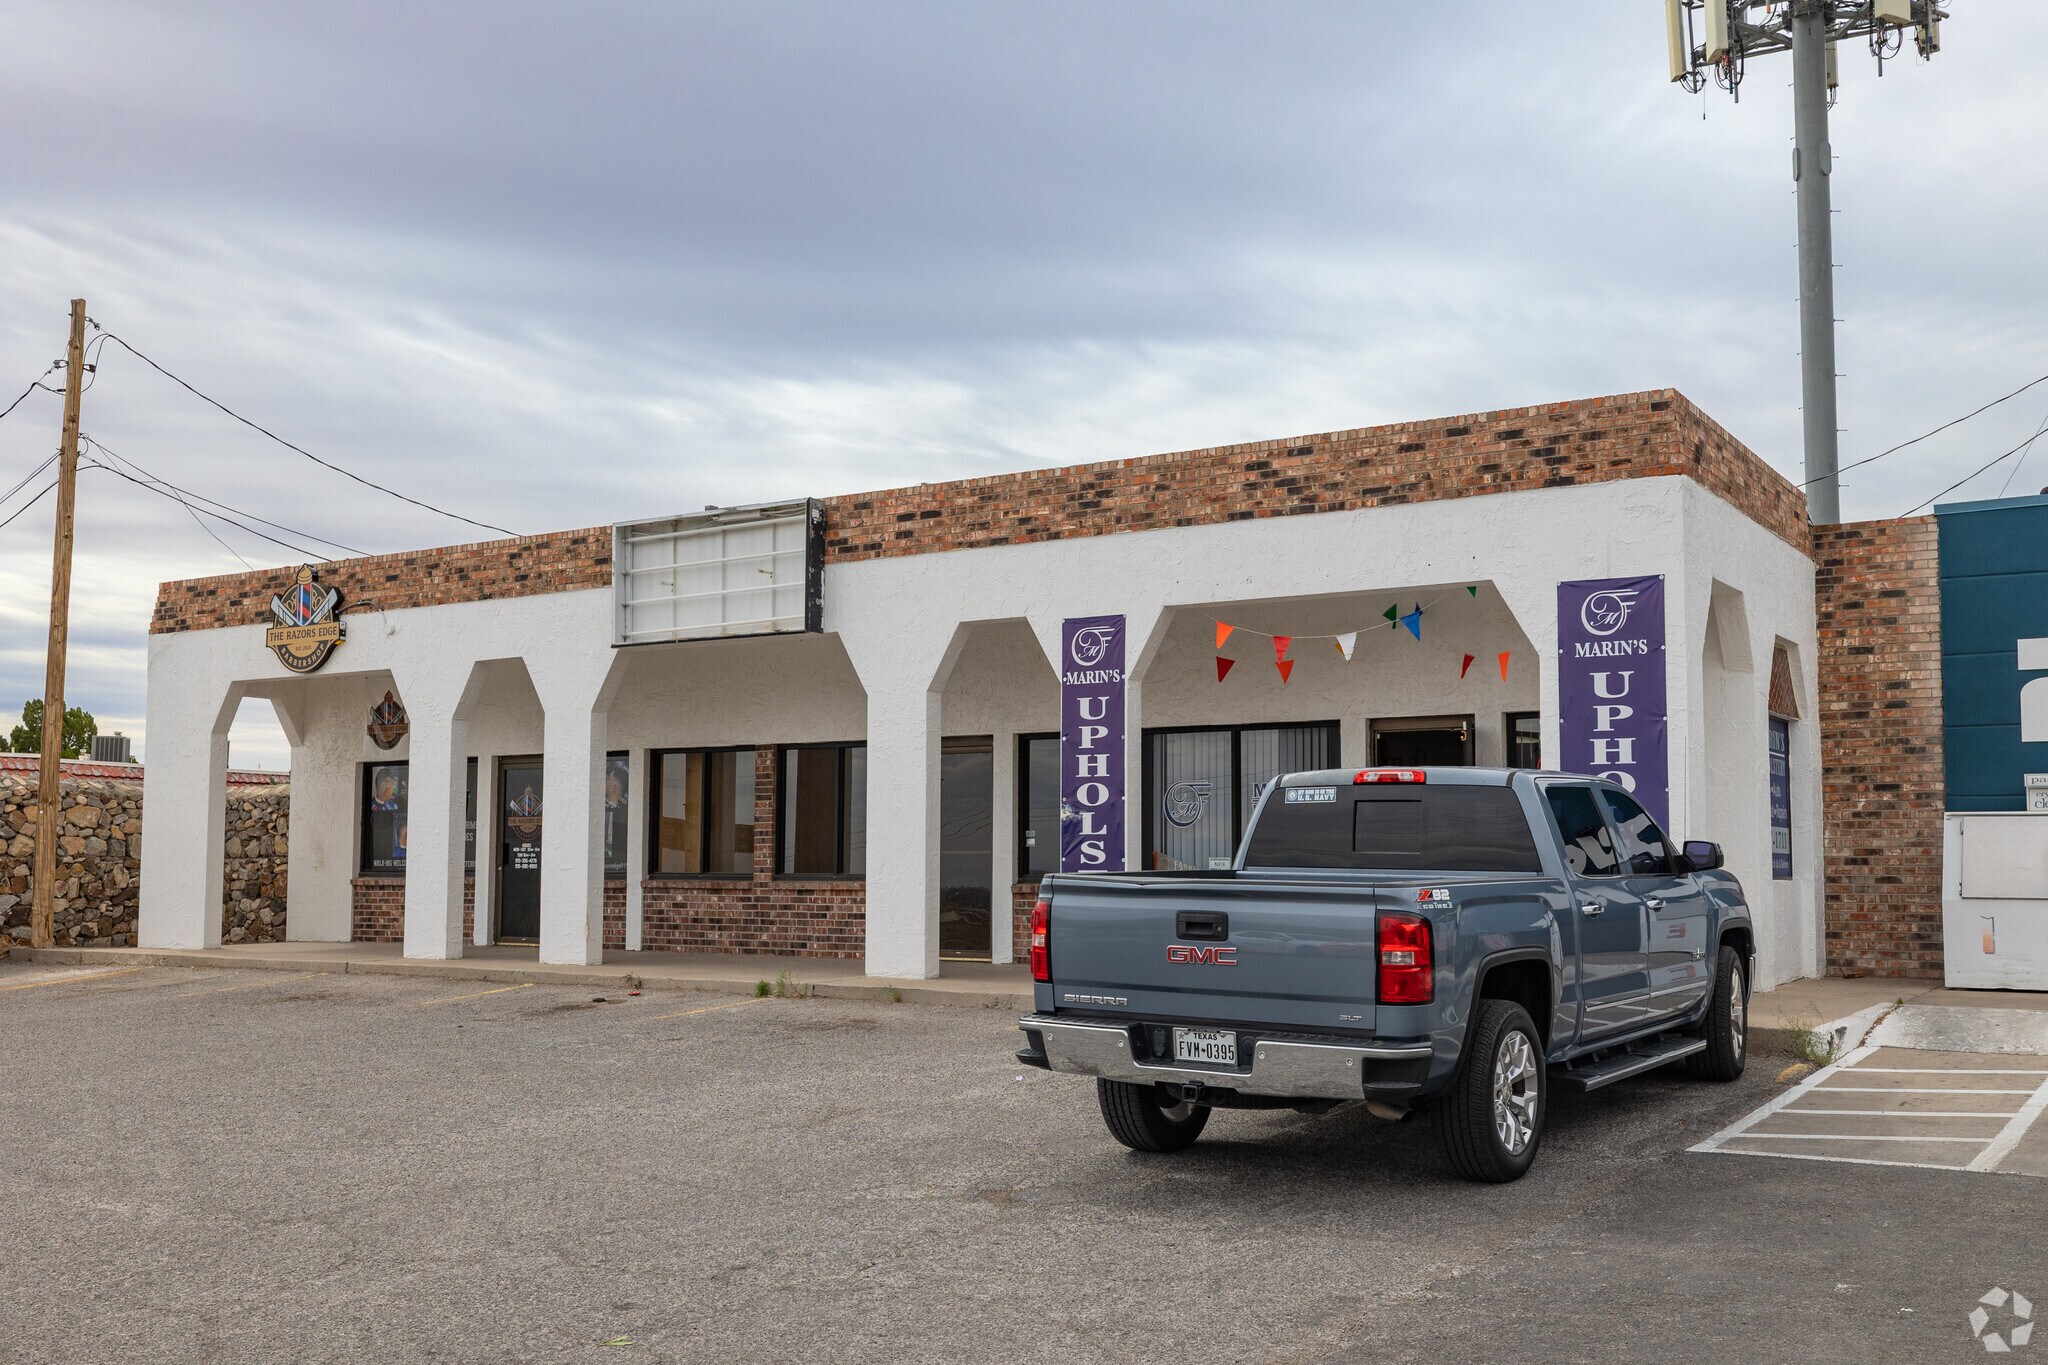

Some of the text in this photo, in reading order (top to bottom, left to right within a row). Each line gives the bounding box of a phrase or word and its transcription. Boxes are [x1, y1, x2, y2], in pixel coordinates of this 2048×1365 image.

[269, 626, 337, 642] THE RAZORS EDGE
[280, 643, 324, 667] BARBERSHOP
[1575, 639, 1648, 658] MARIN'S
[1066, 669, 1120, 685] MARIN'S
[2031, 777, 2048, 785] pa
[373, 859, 392, 867] WALK-INS
[1416, 889, 1451, 902] Z82
[1166, 945, 1238, 966] GMC
[1064, 993, 1128, 1006] SIERRA
[1193, 1032, 1218, 1041] TEXAS
